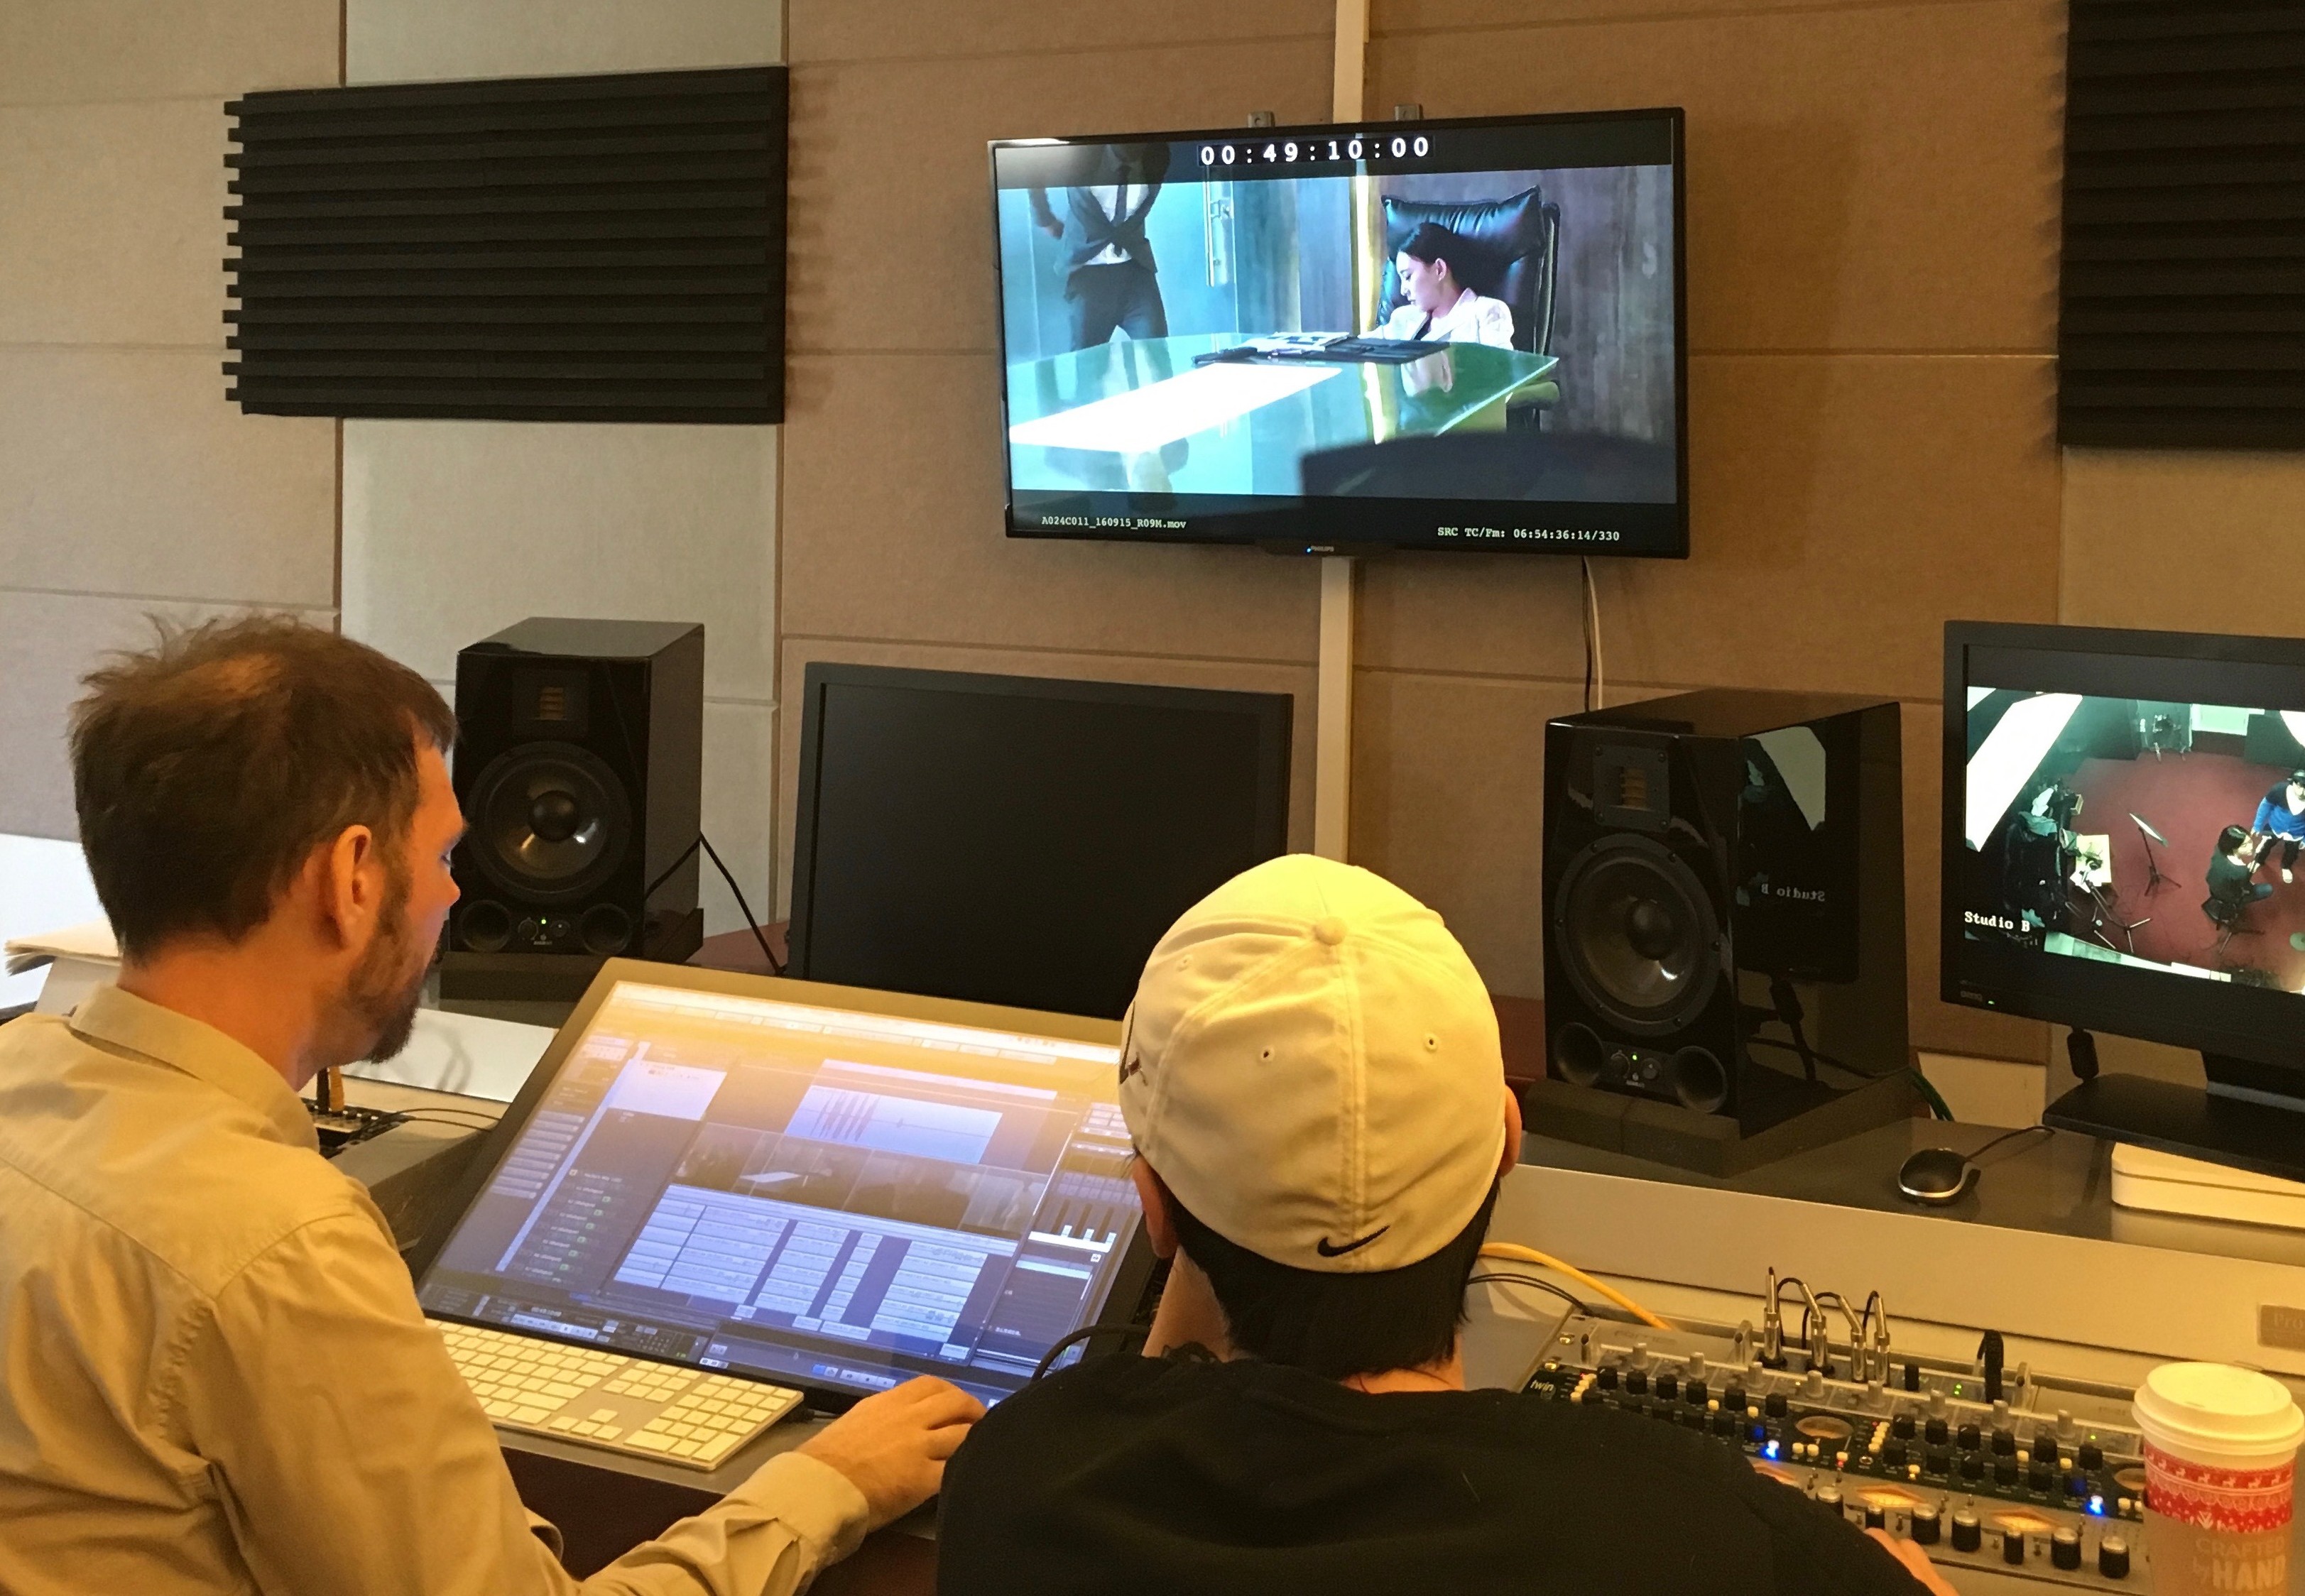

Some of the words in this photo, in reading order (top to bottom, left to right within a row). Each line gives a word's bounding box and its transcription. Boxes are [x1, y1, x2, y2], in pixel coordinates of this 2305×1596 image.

[1200, 136, 1429, 165] 00:49:10:00
[1437, 527, 1459, 537] SRC
[1464, 527, 1505, 538] TC/Fm:
[1513, 528, 1620, 541] 06:54:36:14/330
[1963, 911, 2015, 930] Studio
[2021, 919, 2031, 932] B
[2212, 1553, 2287, 1591] HAND
